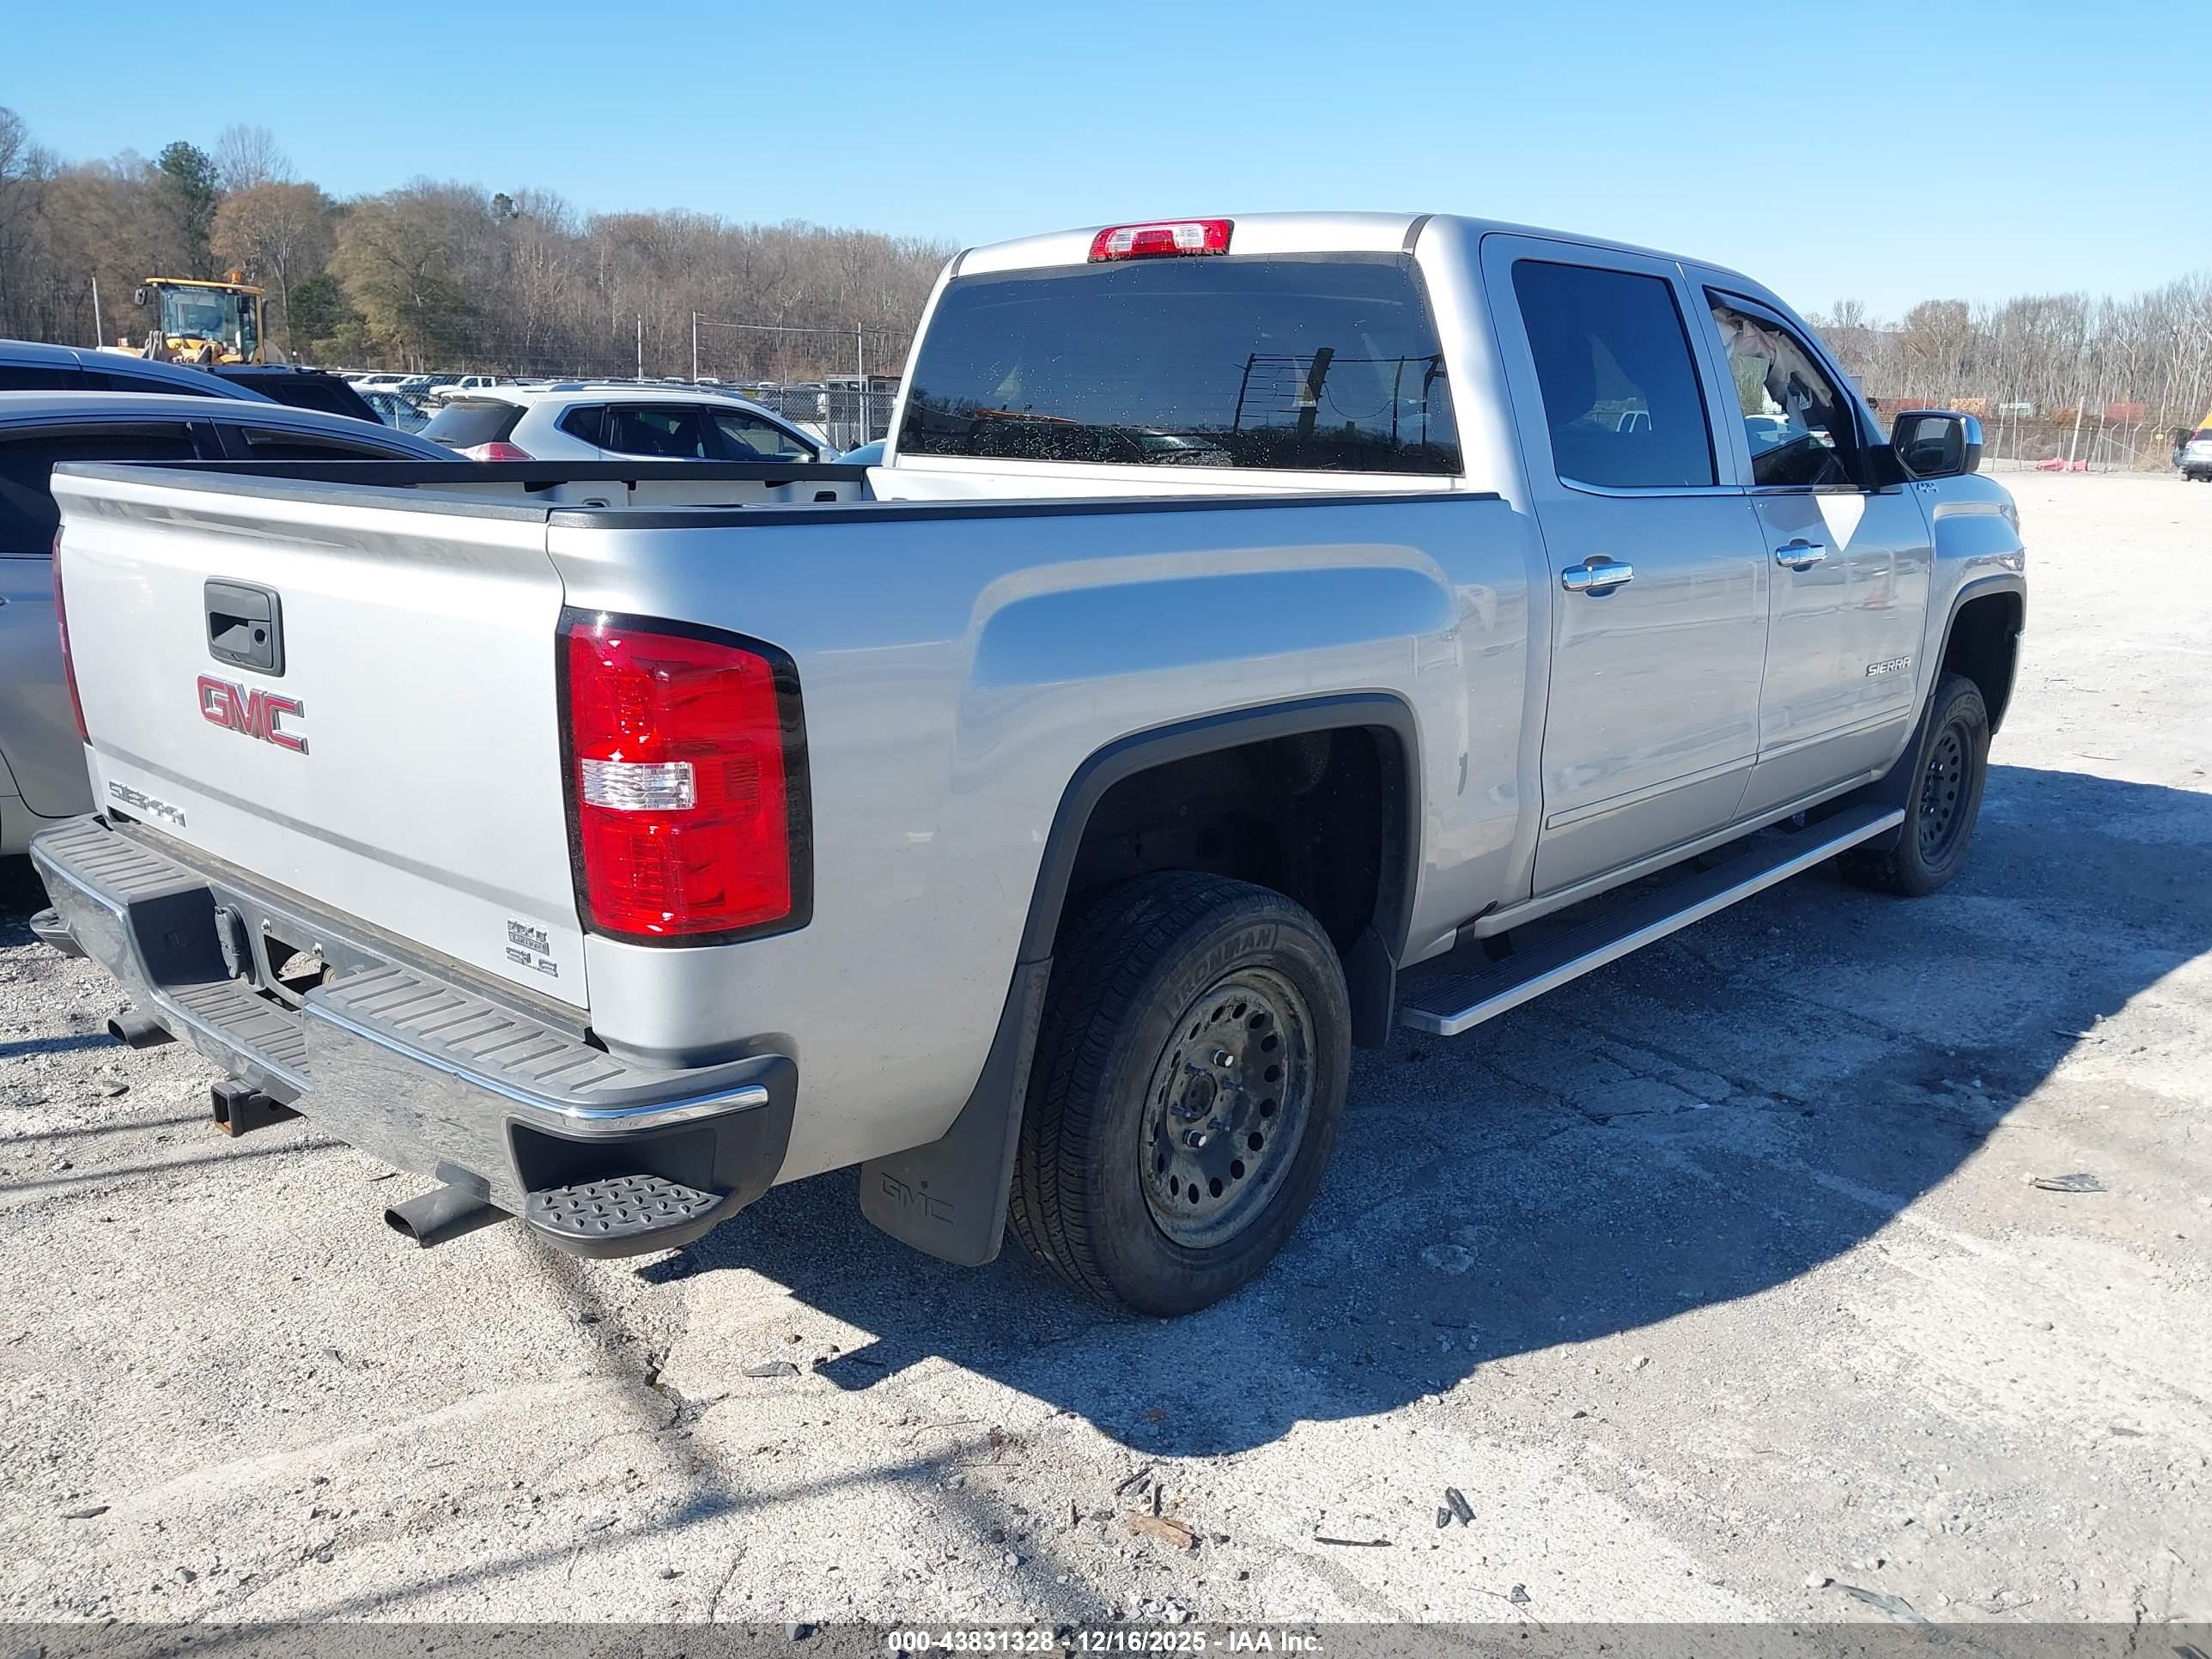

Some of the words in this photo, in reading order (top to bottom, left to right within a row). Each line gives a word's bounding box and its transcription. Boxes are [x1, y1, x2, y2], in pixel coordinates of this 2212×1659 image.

[1865, 655, 1911, 677] SIERRA
[197, 672, 310, 756] GMC
[108, 781, 186, 828] SIERRA
[1170, 927, 1272, 1011] IRONMAN
[881, 1172, 955, 1229] GMC
